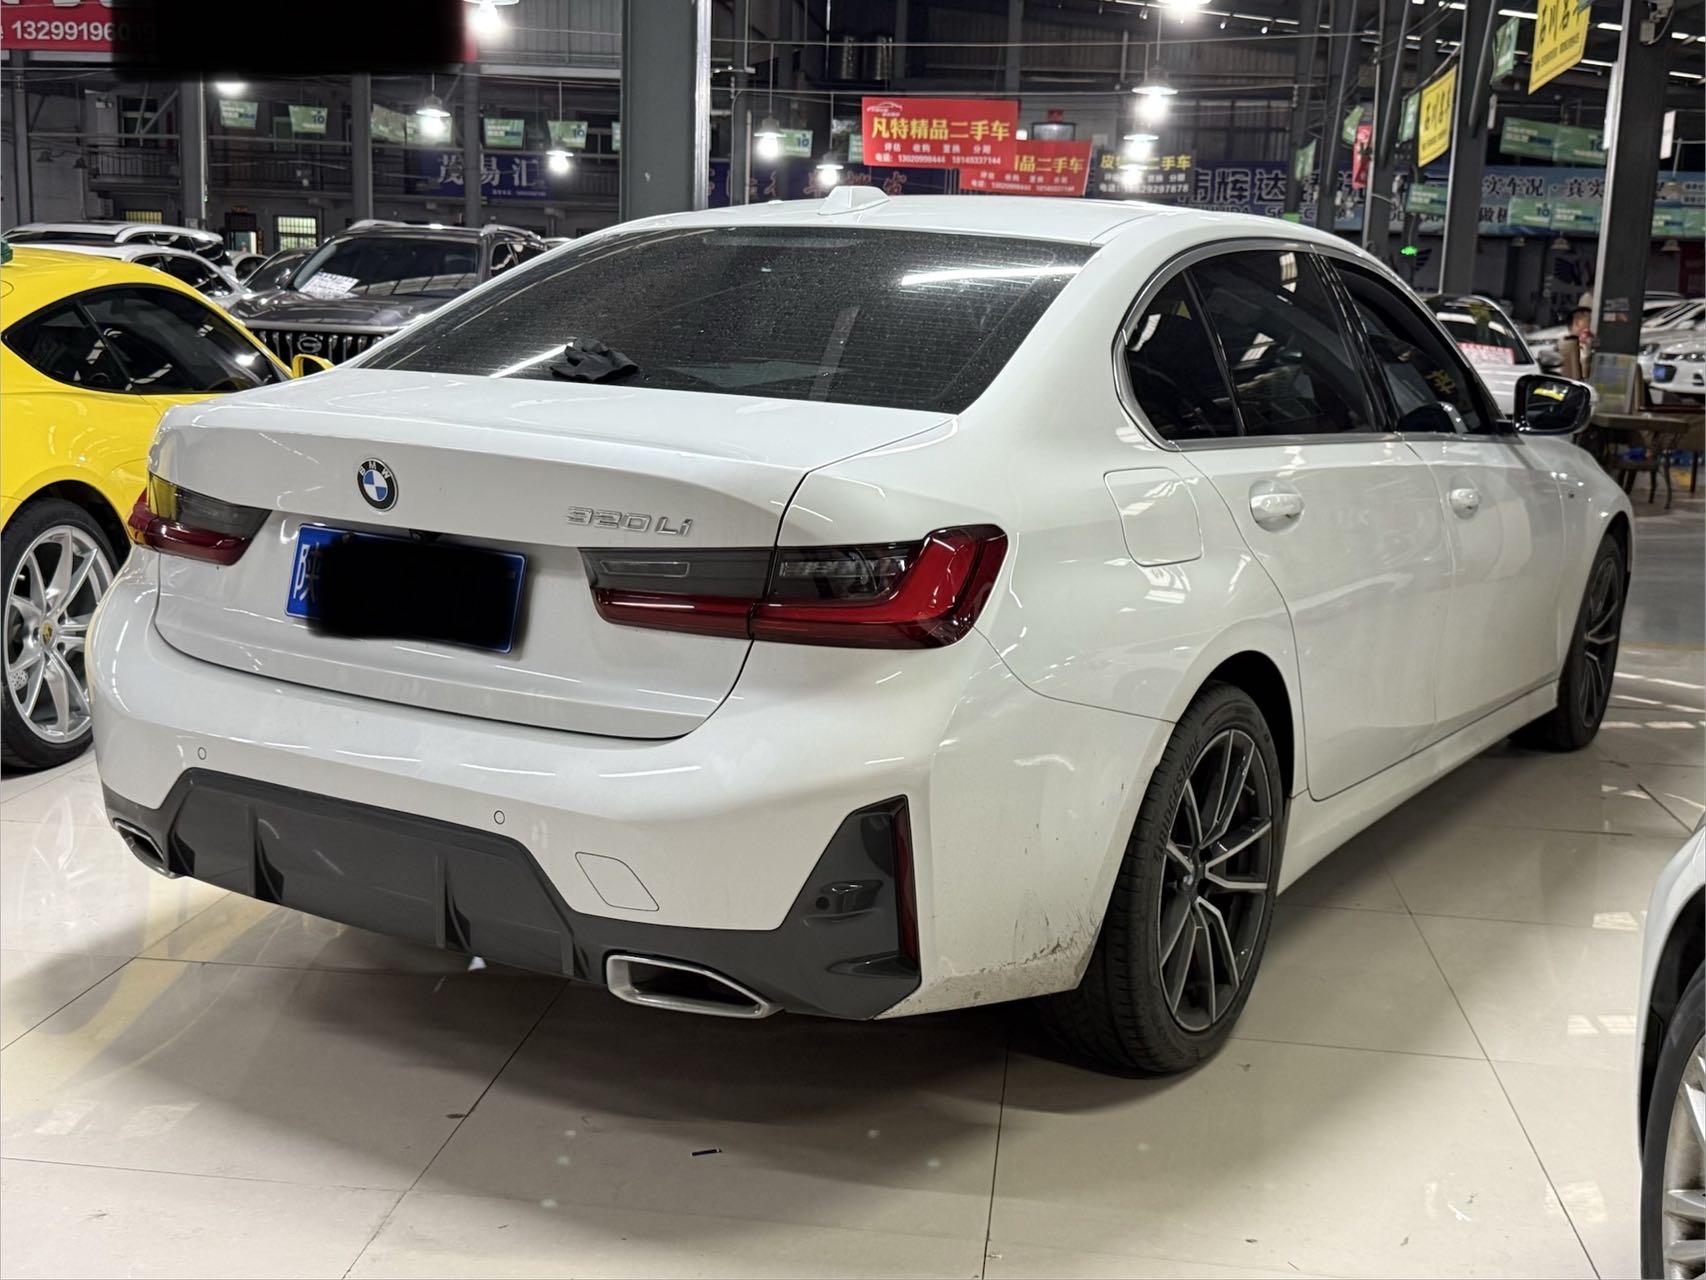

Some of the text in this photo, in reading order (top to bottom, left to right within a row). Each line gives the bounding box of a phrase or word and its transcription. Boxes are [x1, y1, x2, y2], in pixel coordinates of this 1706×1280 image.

[871, 116, 1010, 142] 凡特精品二手车
[1014, 154, 1084, 174] 品二手车
[359, 460, 391, 480] BMW
